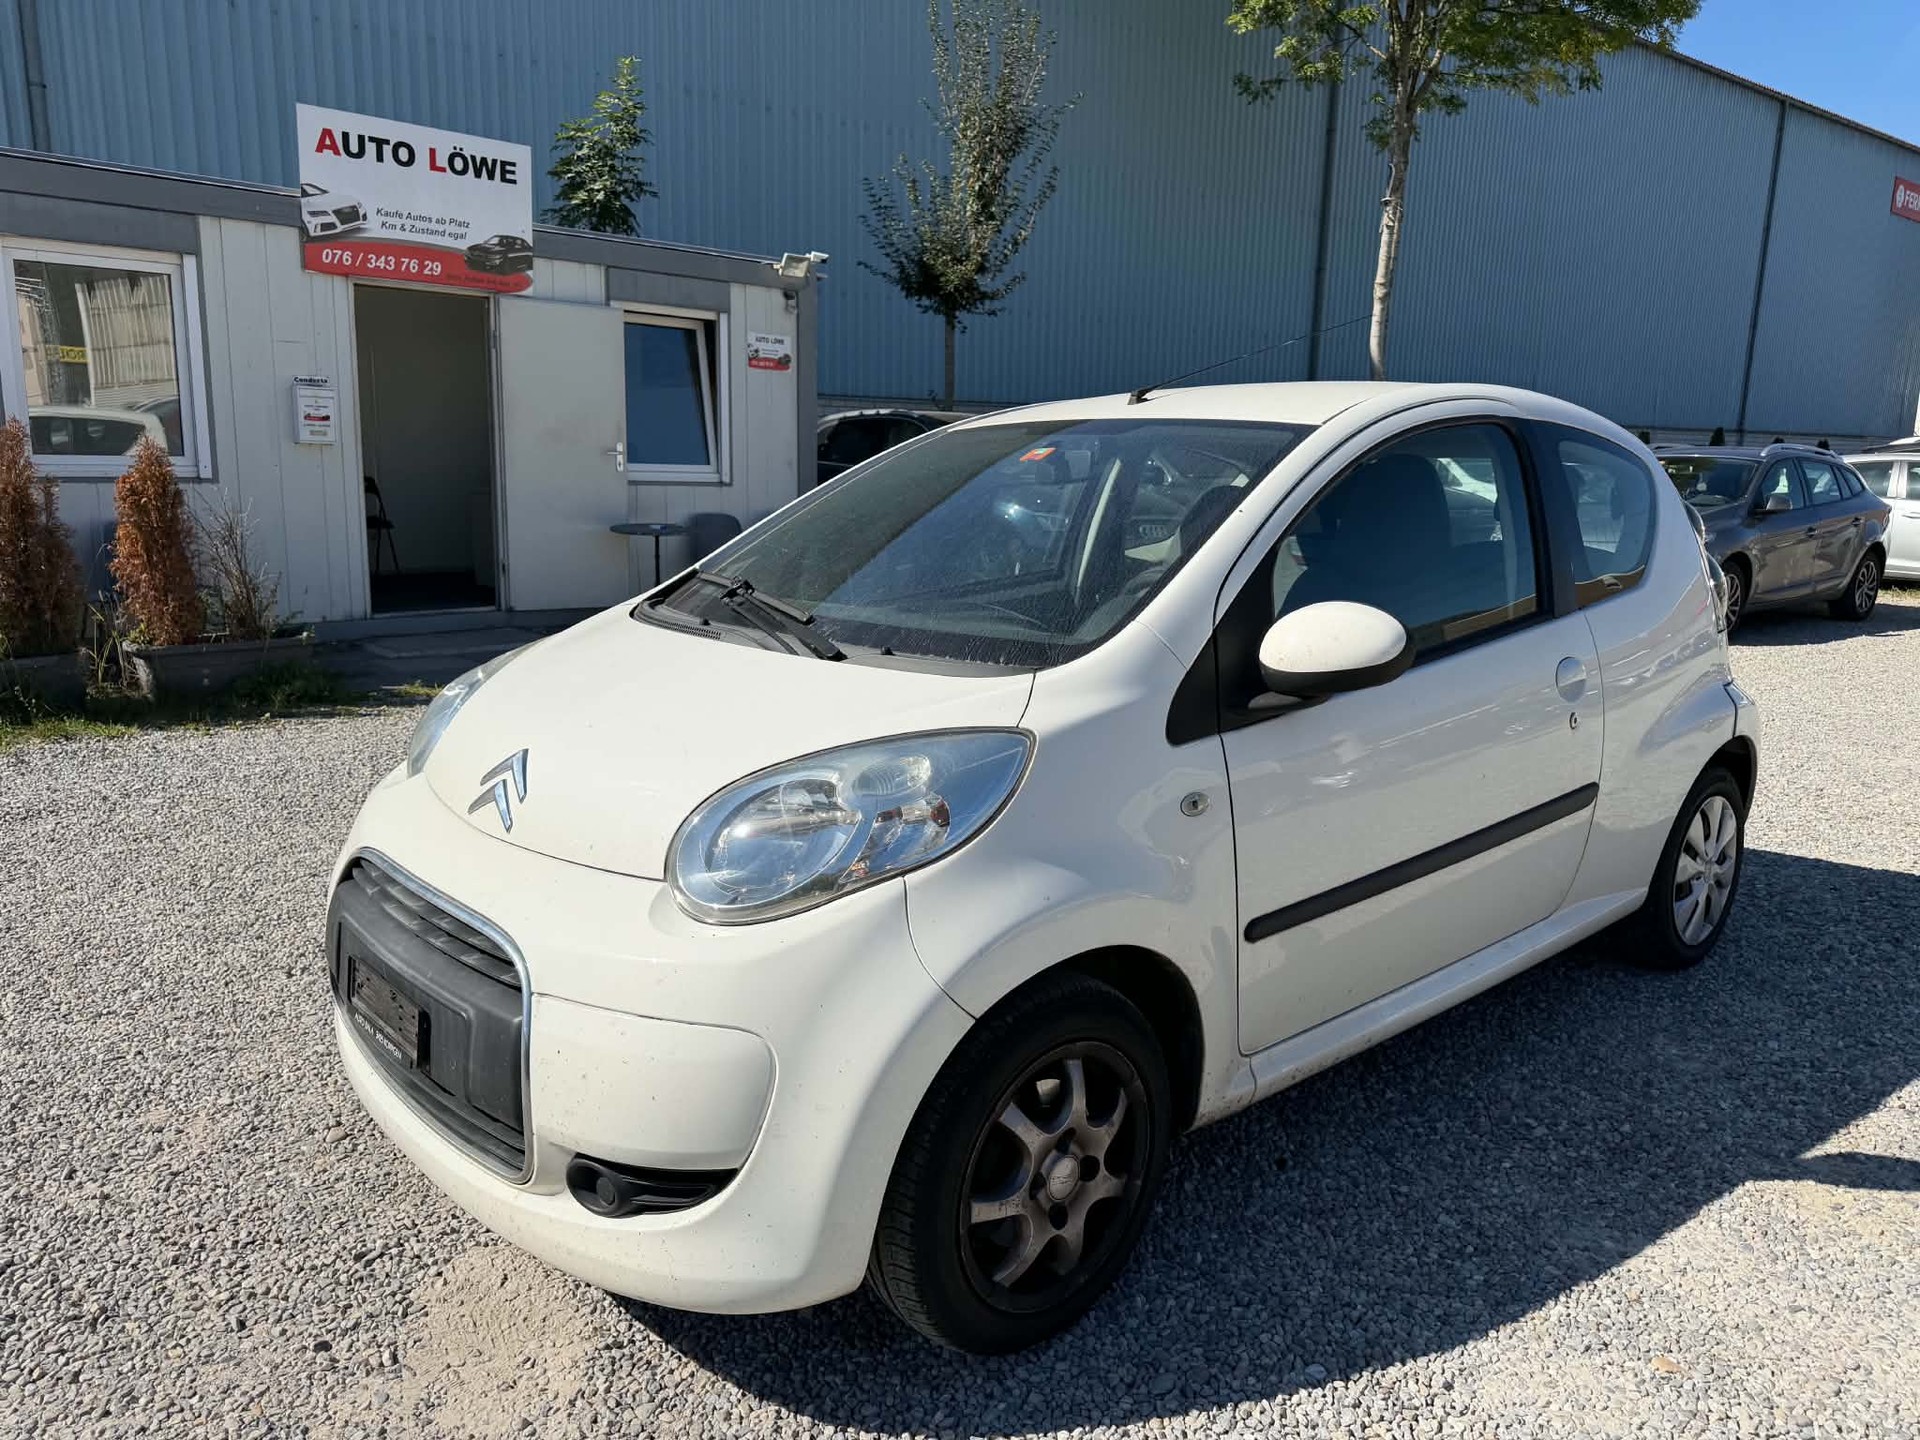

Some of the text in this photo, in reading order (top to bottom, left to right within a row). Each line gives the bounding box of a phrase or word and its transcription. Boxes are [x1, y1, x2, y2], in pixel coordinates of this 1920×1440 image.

[315, 128, 518, 185] AUTO LÖWE
[376, 207, 471, 229] Kaufe Autos ab Platz
[380, 220, 467, 241] Km & Zustand egal
[322, 248, 442, 276] 076 / 343 76 29
